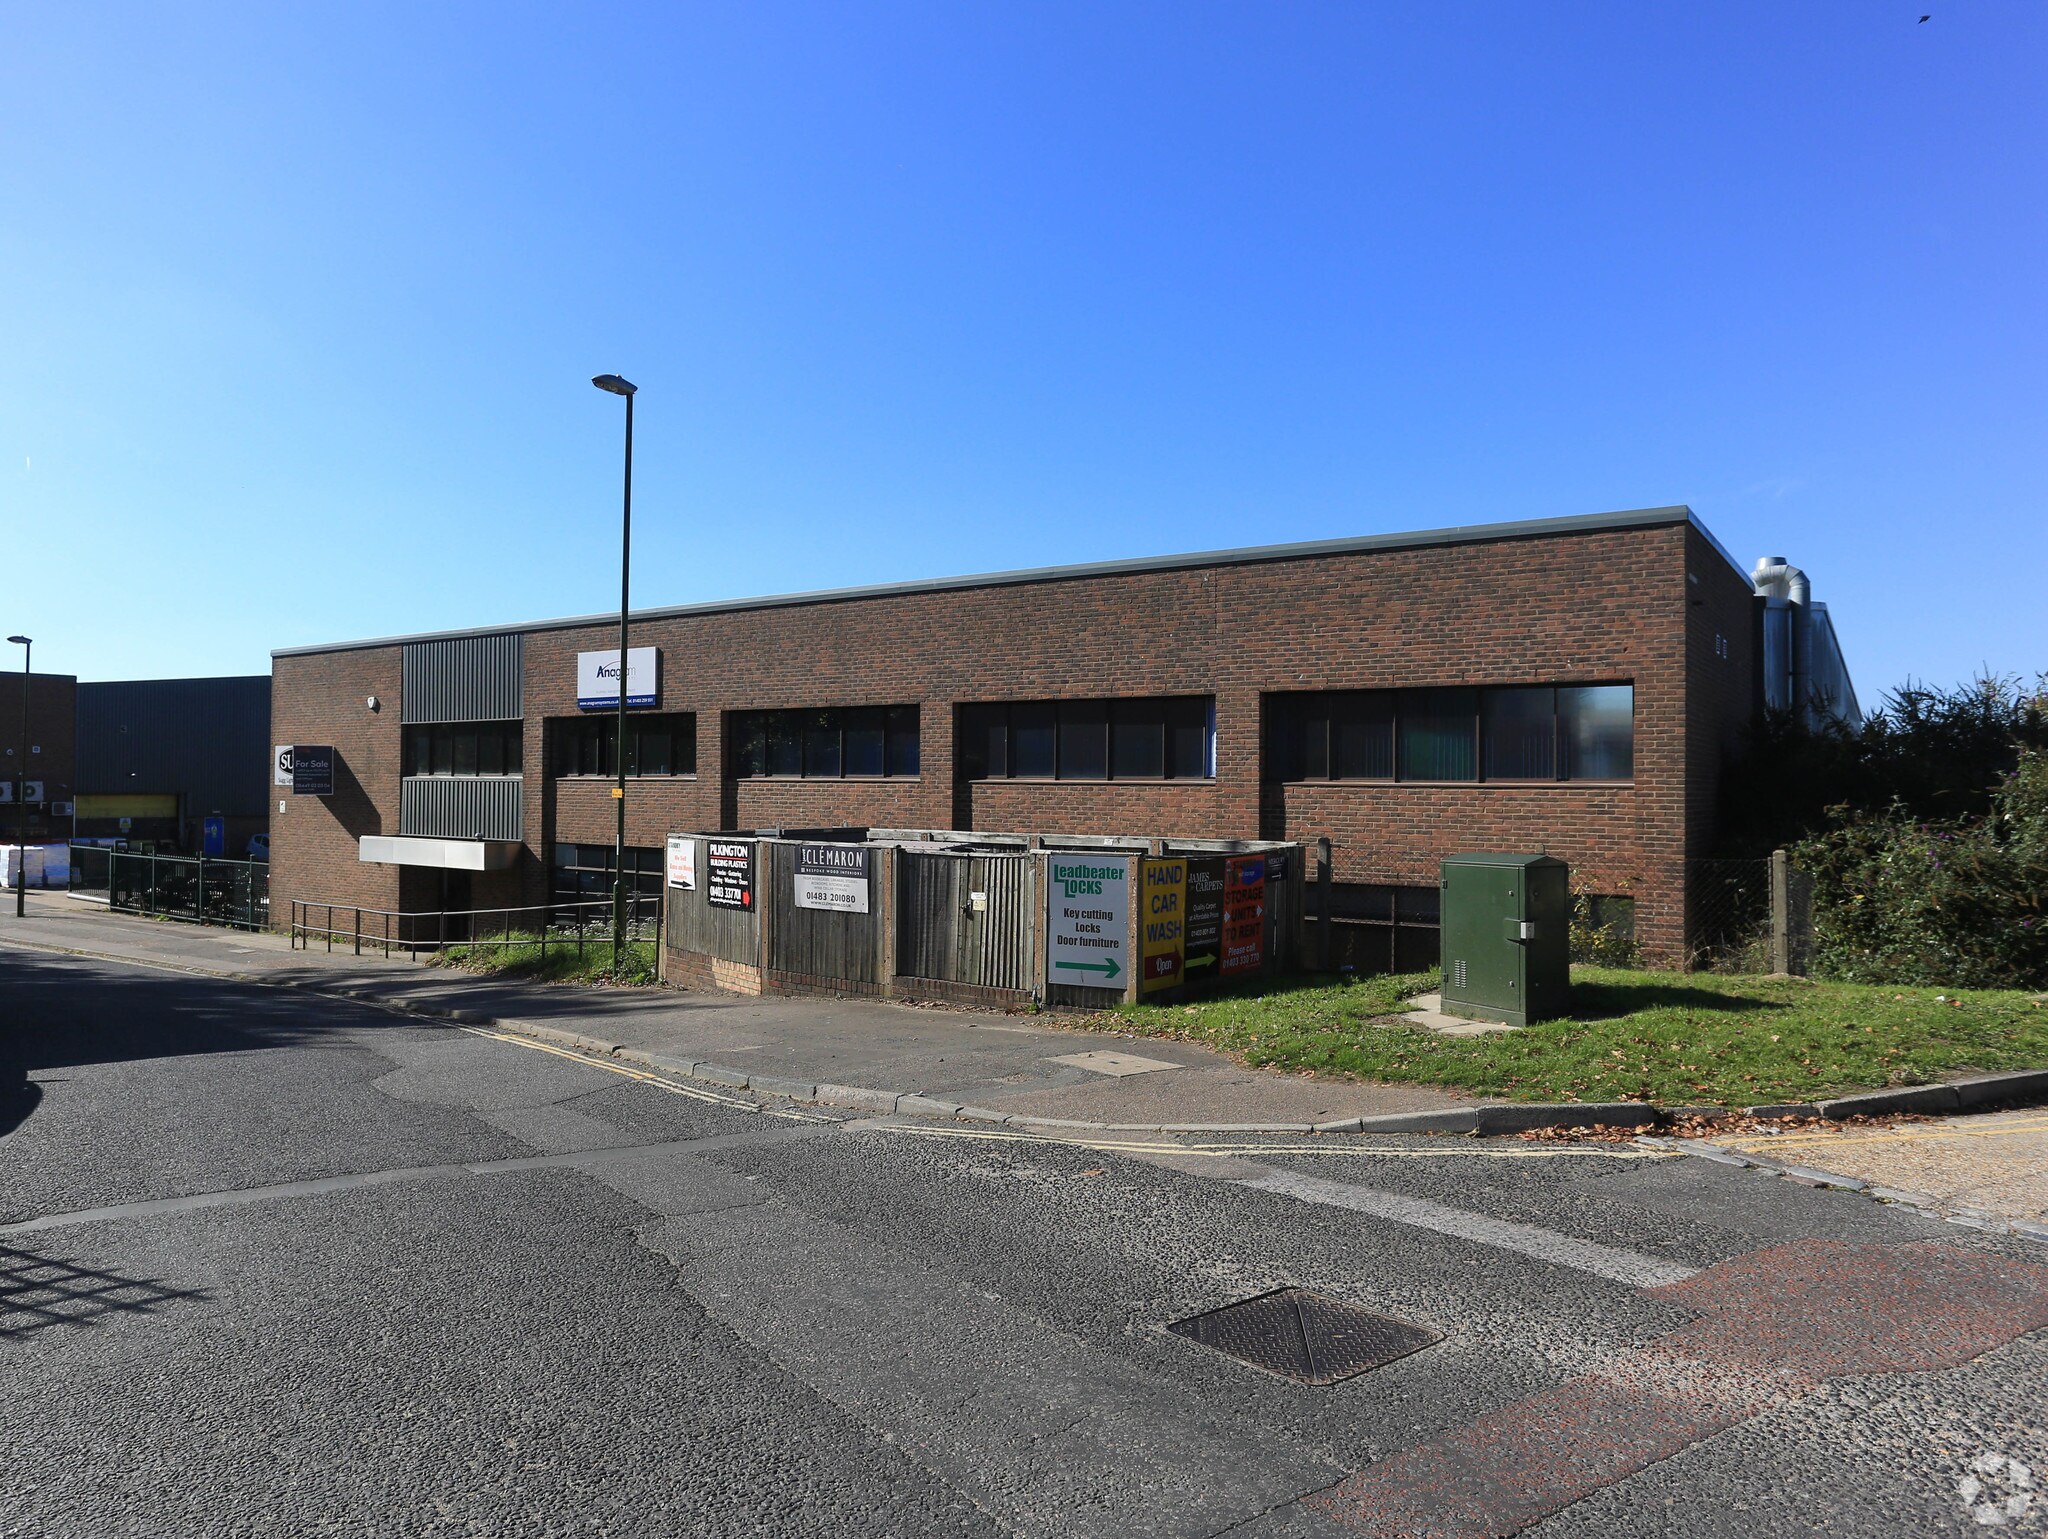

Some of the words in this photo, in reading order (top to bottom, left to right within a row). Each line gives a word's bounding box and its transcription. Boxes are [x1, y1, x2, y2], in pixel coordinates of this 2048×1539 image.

[596, 665, 637, 681] Anagam
[296, 760, 308, 768] For
[310, 760, 328, 768] Sale
[710, 844, 748, 858] PILKINGTON
[806, 846, 863, 868] CLÉMARON
[710, 859, 728, 868] BUILDING
[728, 860, 748, 869] PLASTICS
[1054, 864, 1124, 883] Leadbeater
[1147, 865, 1182, 887] HAND
[1188, 872, 1210, 883] JAMES
[1064, 879, 1102, 898] LOCKS
[1195, 880, 1224, 892] CARPETS
[806, 892, 827, 900] 01483
[830, 893, 856, 903] 201080
[1151, 893, 1177, 914] CAR
[1225, 886, 1264, 905] STORAGE
[1064, 908, 1080, 919] Key
[1081, 909, 1113, 921] cutting
[1232, 905, 1257, 922] UNITS
[1076, 922, 1101, 933] Locks
[1146, 920, 1182, 942] WASH
[1225, 927, 1237, 941] TO
[1239, 922, 1262, 937] RENT
[1057, 935, 1078, 946] Door
[1079, 936, 1119, 948] furniture
[1228, 946, 1246, 956] Please
[1246, 942, 1256, 952] call
[1156, 957, 1172, 975] Open
